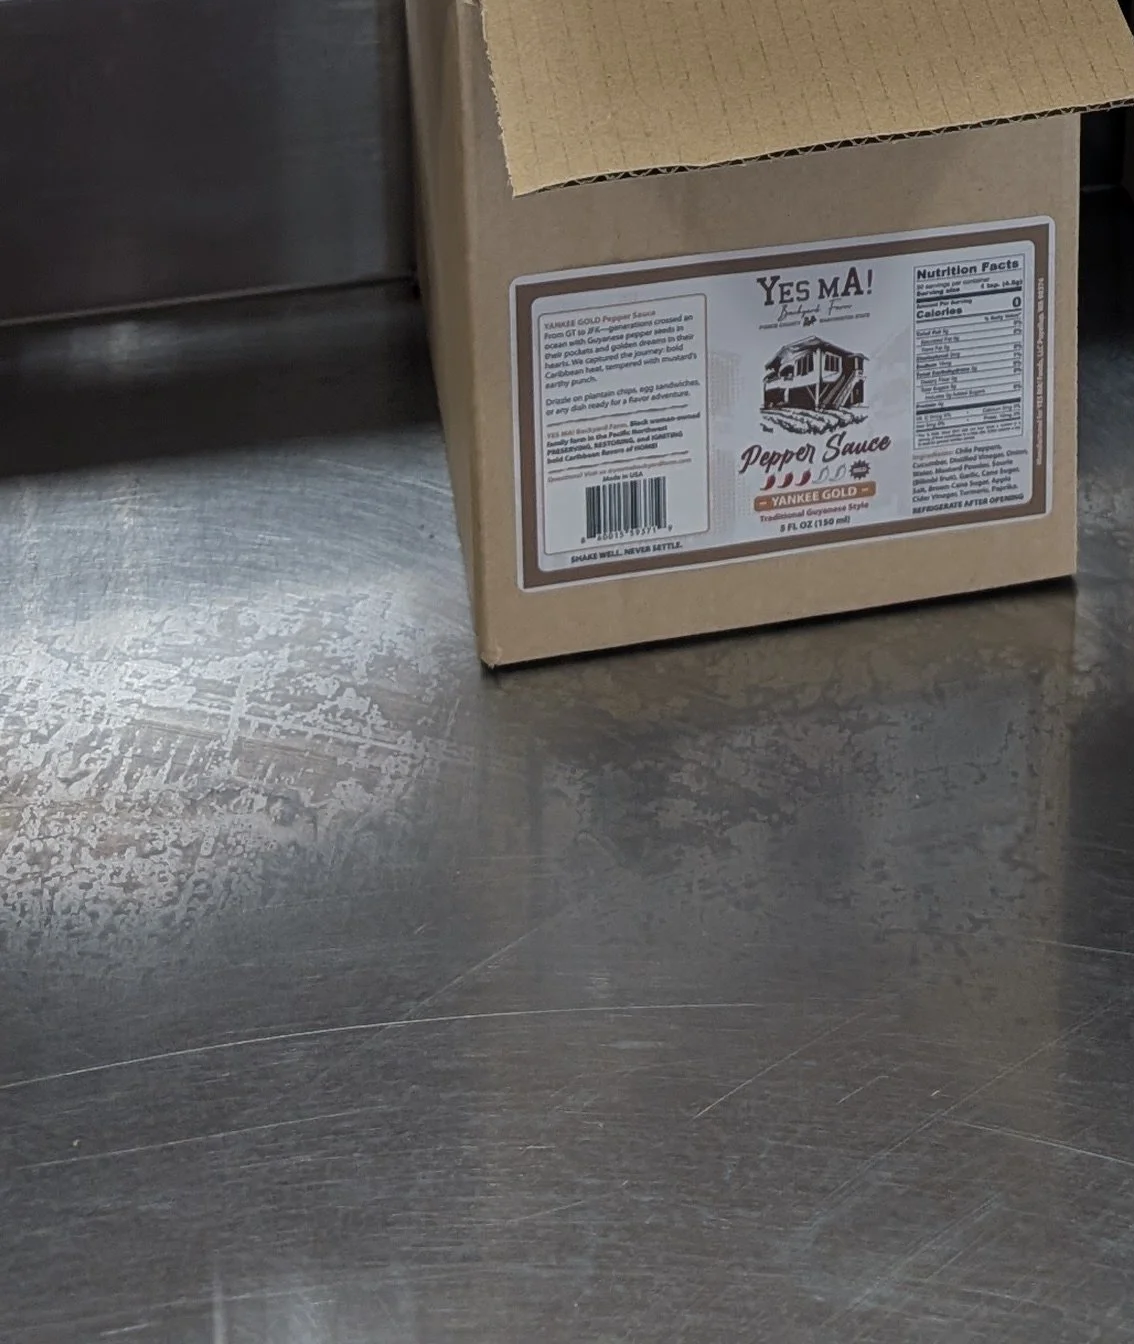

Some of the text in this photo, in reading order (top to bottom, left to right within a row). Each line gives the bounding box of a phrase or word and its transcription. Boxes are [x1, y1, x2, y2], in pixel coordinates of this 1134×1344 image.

[916, 259, 1019, 280] Nutrition Facts
[756, 275, 810, 307] YES
[737, 442, 816, 474] Pepper
[821, 431, 892, 463] Sauce
[771, 486, 857, 507] YANKEE GOLD
[779, 515, 850, 533] 5 FL OZ (150 ml)
